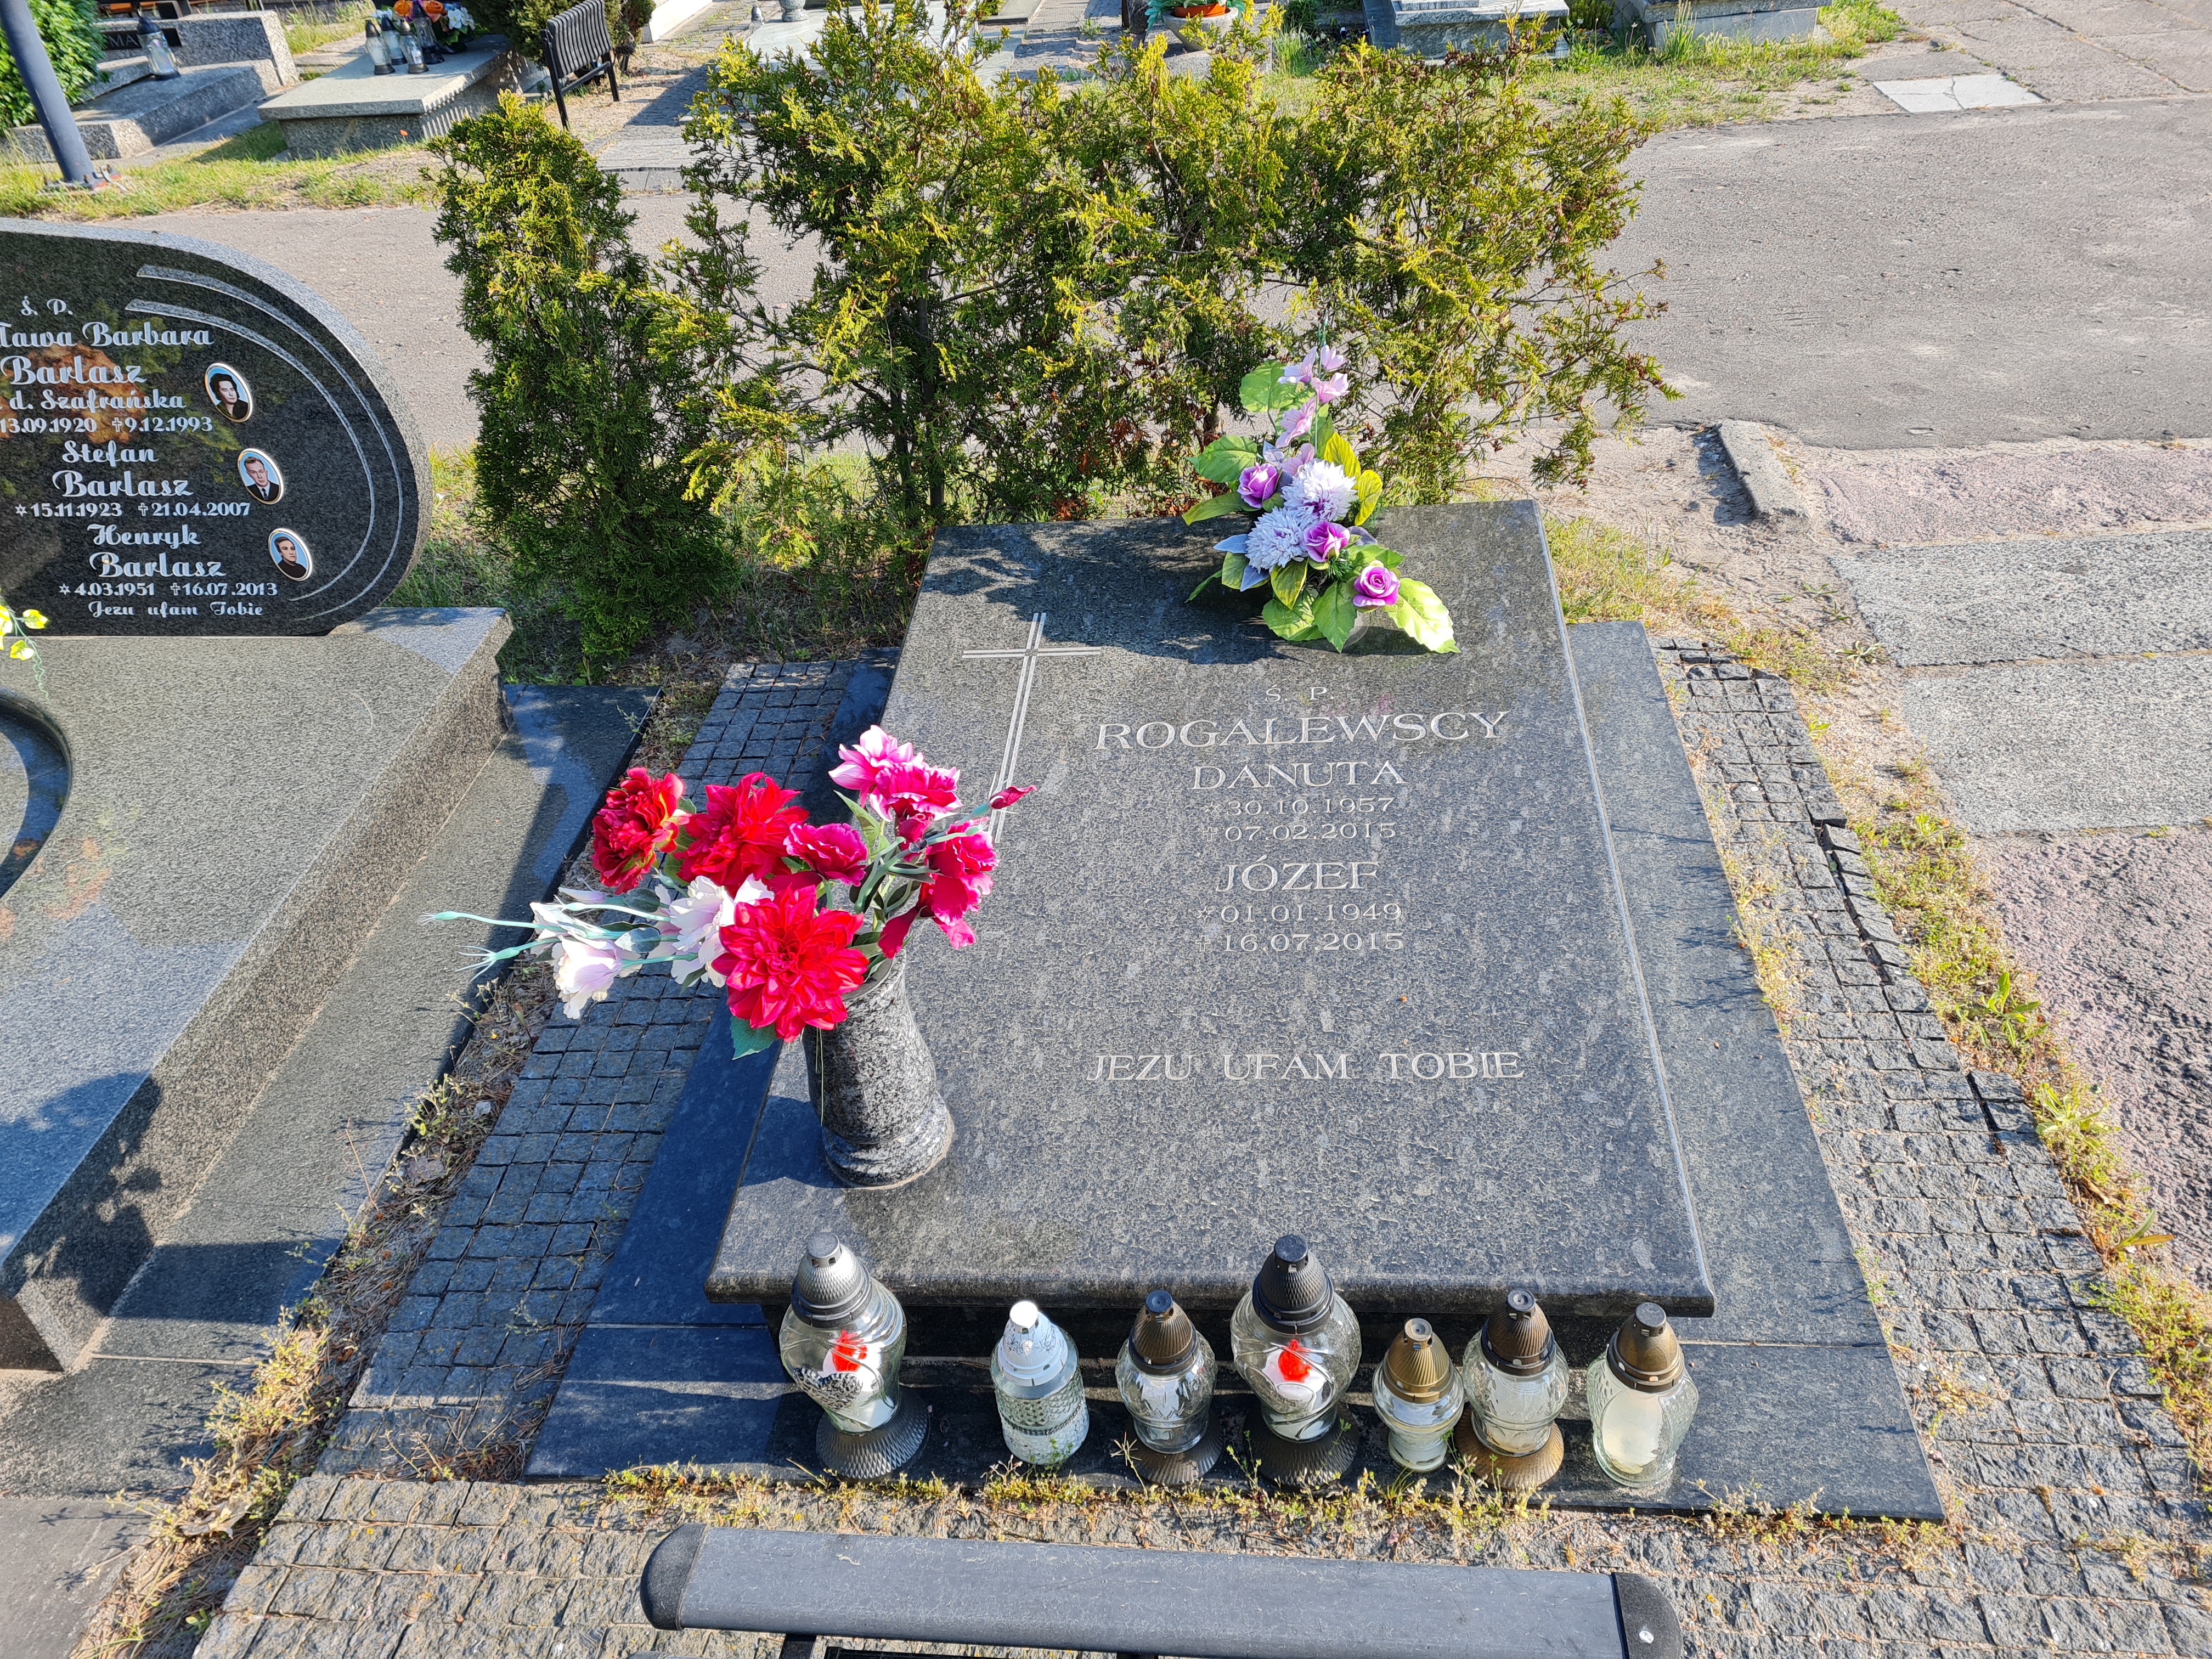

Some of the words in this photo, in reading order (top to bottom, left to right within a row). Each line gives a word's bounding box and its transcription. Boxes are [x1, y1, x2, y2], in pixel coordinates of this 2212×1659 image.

[21, 295, 38, 316] Ś.
[46, 298, 74, 315] P.
[0, 321, 77, 347] ława
[82, 321, 214, 347] Barbara
[1, 355, 148, 385] Barlasz
[9, 390, 34, 410] d.
[41, 388, 187, 414] Szafrańska
[0, 417, 97, 434] 13.09.1920
[125, 416, 213, 433] 9.12.1993
[62, 440, 159, 467] Stefan
[52, 470, 194, 498] Barlasz
[31, 503, 122, 517] 15.11.1923
[151, 502, 251, 517] 21.04.2007
[87, 523, 201, 549] Henryk
[89, 552, 227, 578] Barlasz
[75, 583, 155, 596] 4.03.1951
[182, 582, 278, 596] 16.07.2013
[88, 601, 134, 618] Jezu
[148, 602, 199, 618] ufam
[210, 601, 263, 616] Tobie
[1094, 711, 1510, 750] ROGALEWSCY
[1191, 760, 1408, 791] DANUTA
[1226, 797, 1395, 817] 30.10.1957
[1225, 822, 1396, 842] 07.02.2015
[1216, 854, 1380, 893] JÓZEF
[1221, 902, 1402, 923] 01.01.1949
[1223, 932, 1404, 952] 16.07.2015
[1086, 1054, 1195, 1082] JEZU
[1223, 1053, 1352, 1081] UFAM
[1379, 1052, 1526, 1080] TOBIE
